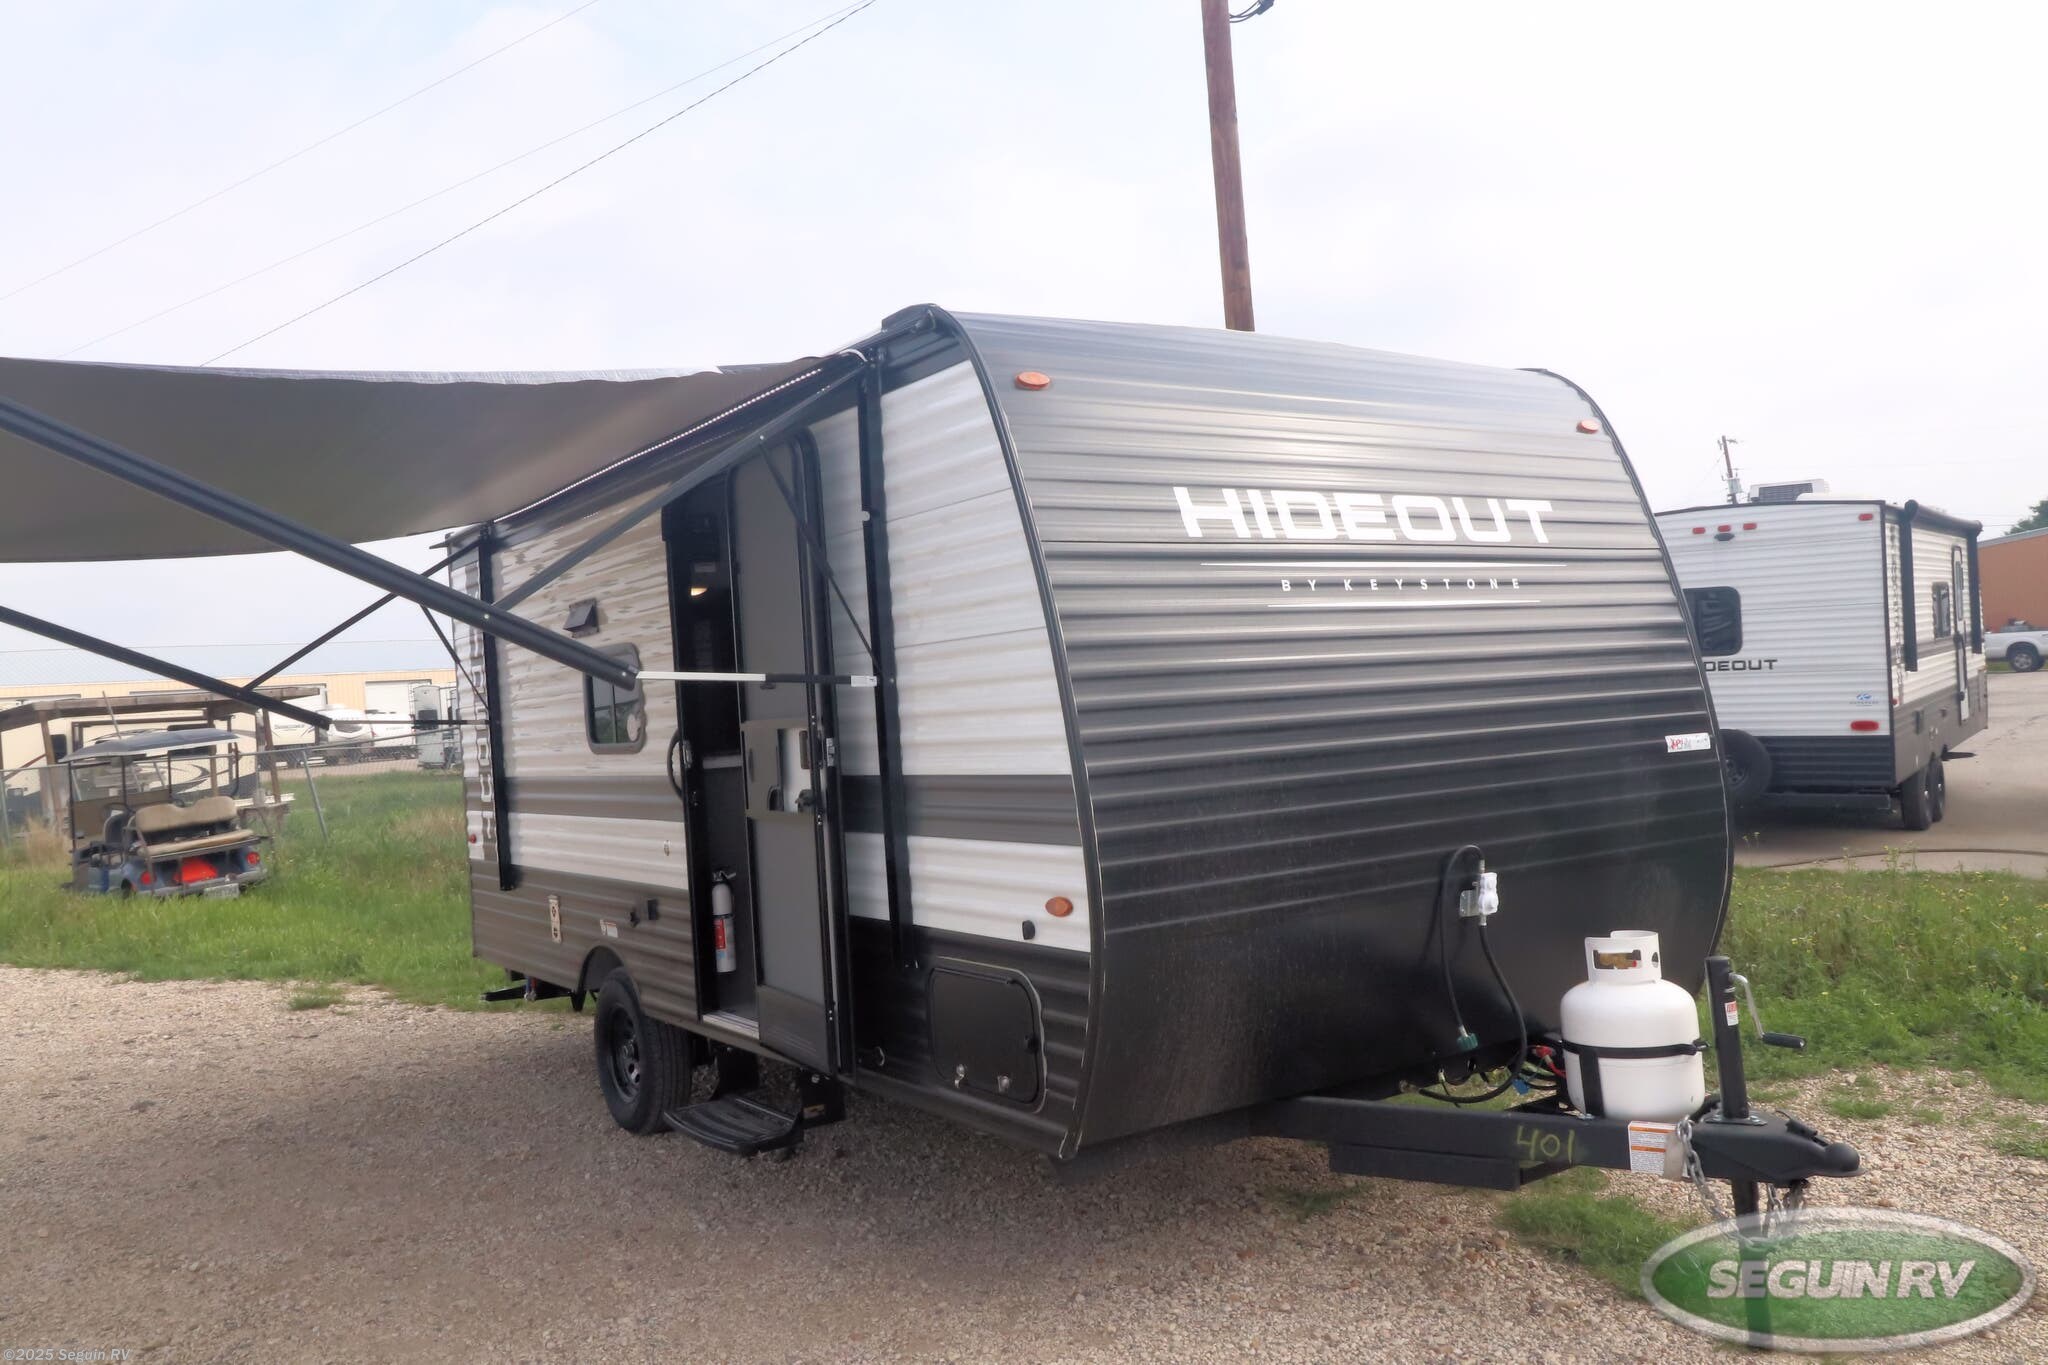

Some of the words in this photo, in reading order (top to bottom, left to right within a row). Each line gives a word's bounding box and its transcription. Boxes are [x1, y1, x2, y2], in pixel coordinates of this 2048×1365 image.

[1173, 486, 1553, 544] HIDEOUT
[1281, 578, 1317, 592] BY
[1344, 577, 1521, 591] KEYSTONE
[1515, 1125, 1575, 1164] 401
